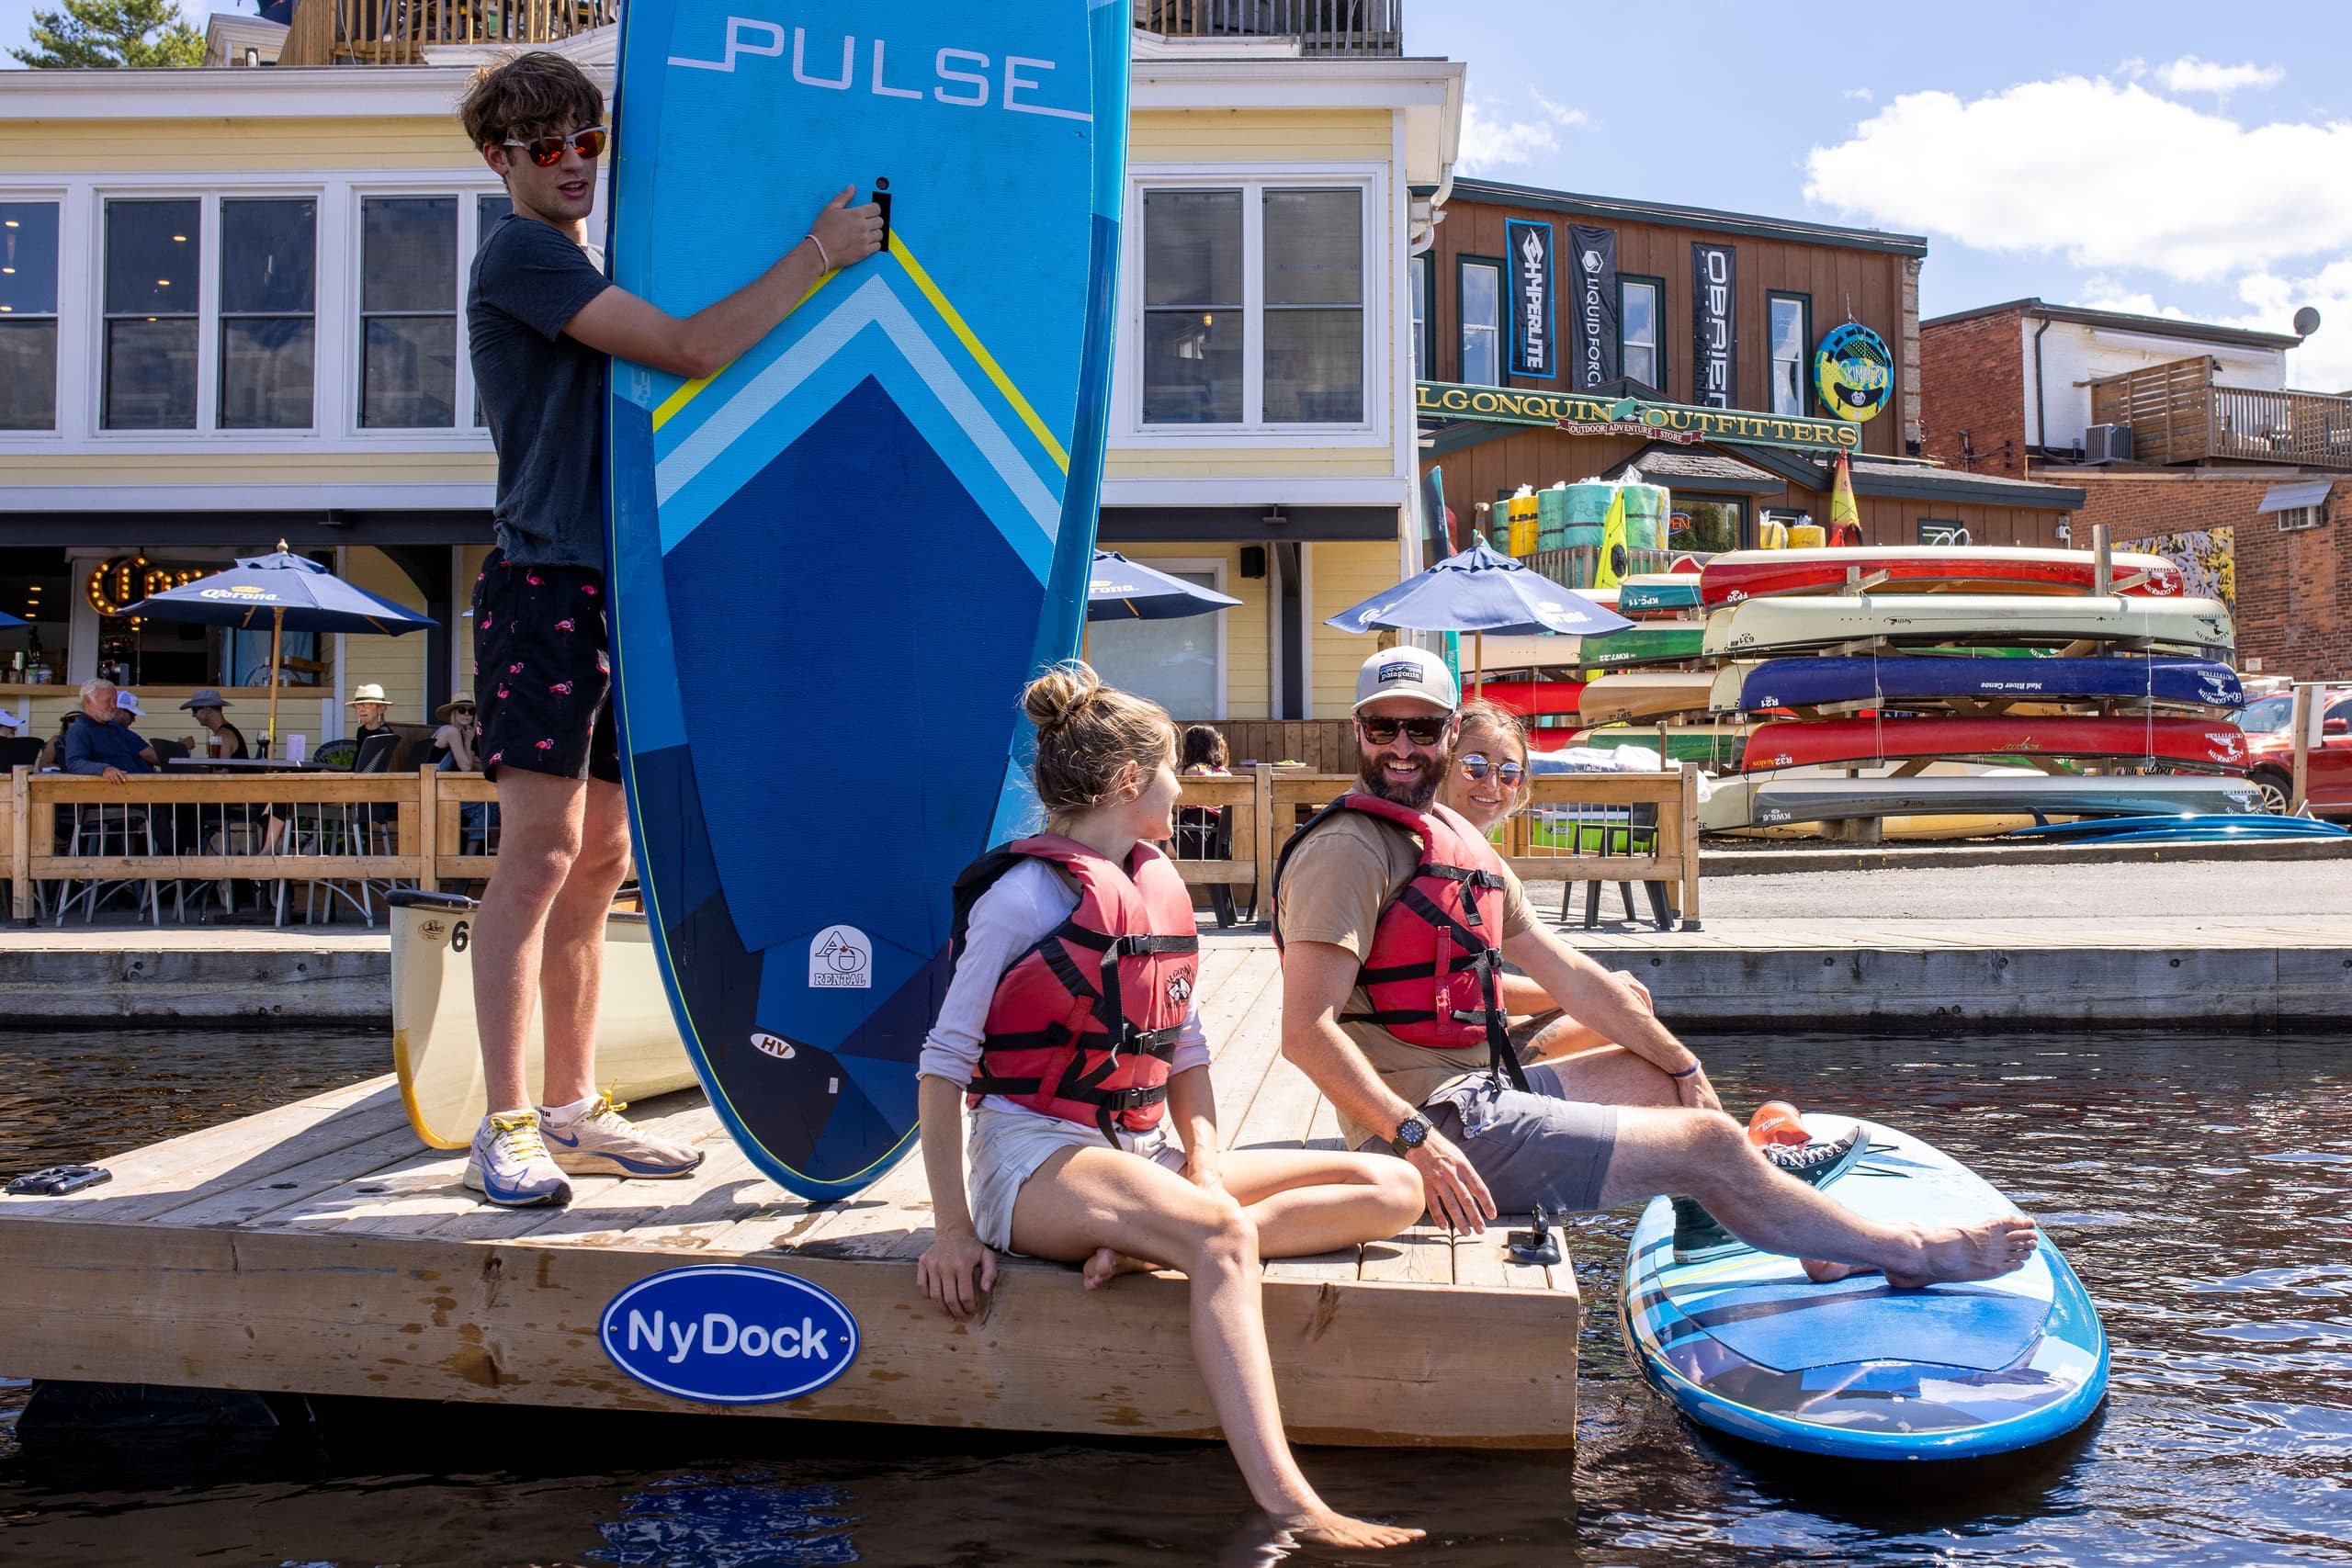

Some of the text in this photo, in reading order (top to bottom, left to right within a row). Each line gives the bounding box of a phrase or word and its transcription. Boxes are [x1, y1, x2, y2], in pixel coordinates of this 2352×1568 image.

[667, 17, 1093, 122] PULSE
[1524, 262, 1544, 368] HYPERLITE
[1587, 278, 1601, 387] LIQUID FORC
[1839, 360, 1883, 386] SKIMMER
[1417, 387, 1858, 446] LGONQUIN OUTFITTERS
[1570, 423, 1683, 443] OUTDOOR ADVENTURE STORE
[200, 588, 279, 602] Corona
[2195, 629, 2230, 643] ALGONQUIN
[1381, 671, 1419, 680] patagonia
[2197, 671, 2234, 682] OUTFITTERS
[1760, 697, 1779, 708] R21
[1774, 756, 1792, 765] R32
[2207, 749, 2244, 763] ALGONQUIN
[1762, 812, 1792, 821] KW6.6
[452, 920, 469, 953] 6
[814, 973, 865, 986] RENTAL
[761, 1036, 790, 1056] HV
[628, 1309, 829, 1364] NyDock
